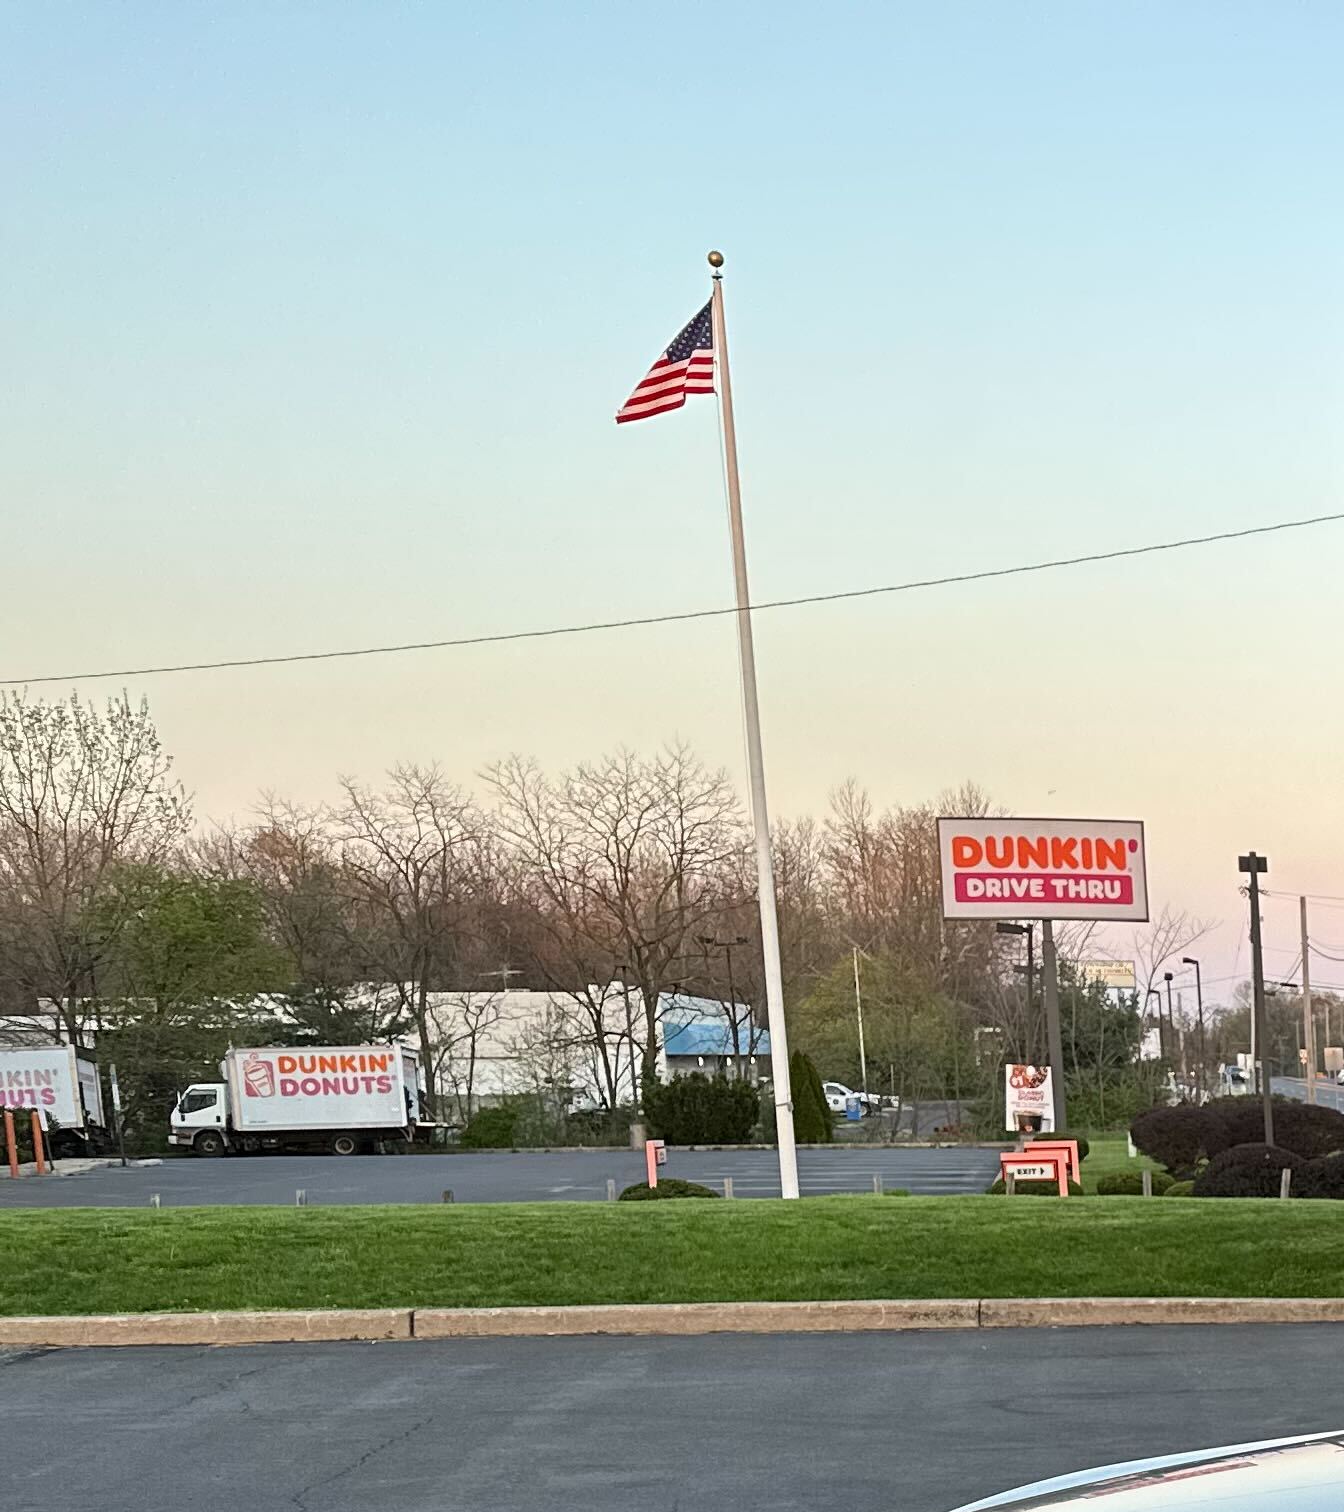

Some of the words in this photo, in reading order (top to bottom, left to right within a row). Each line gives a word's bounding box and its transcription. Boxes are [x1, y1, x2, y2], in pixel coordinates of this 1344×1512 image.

[951, 835, 1139, 871] DUNKIN'
[965, 877, 1046, 898] DRIVE
[1050, 878, 1122, 900] THRU
[277, 1053, 395, 1075] DUNKIN'
[0, 1068, 58, 1089] KIN'
[279, 1075, 393, 1097] DONUTS
[1016, 1167, 1037, 1176] EXIT
